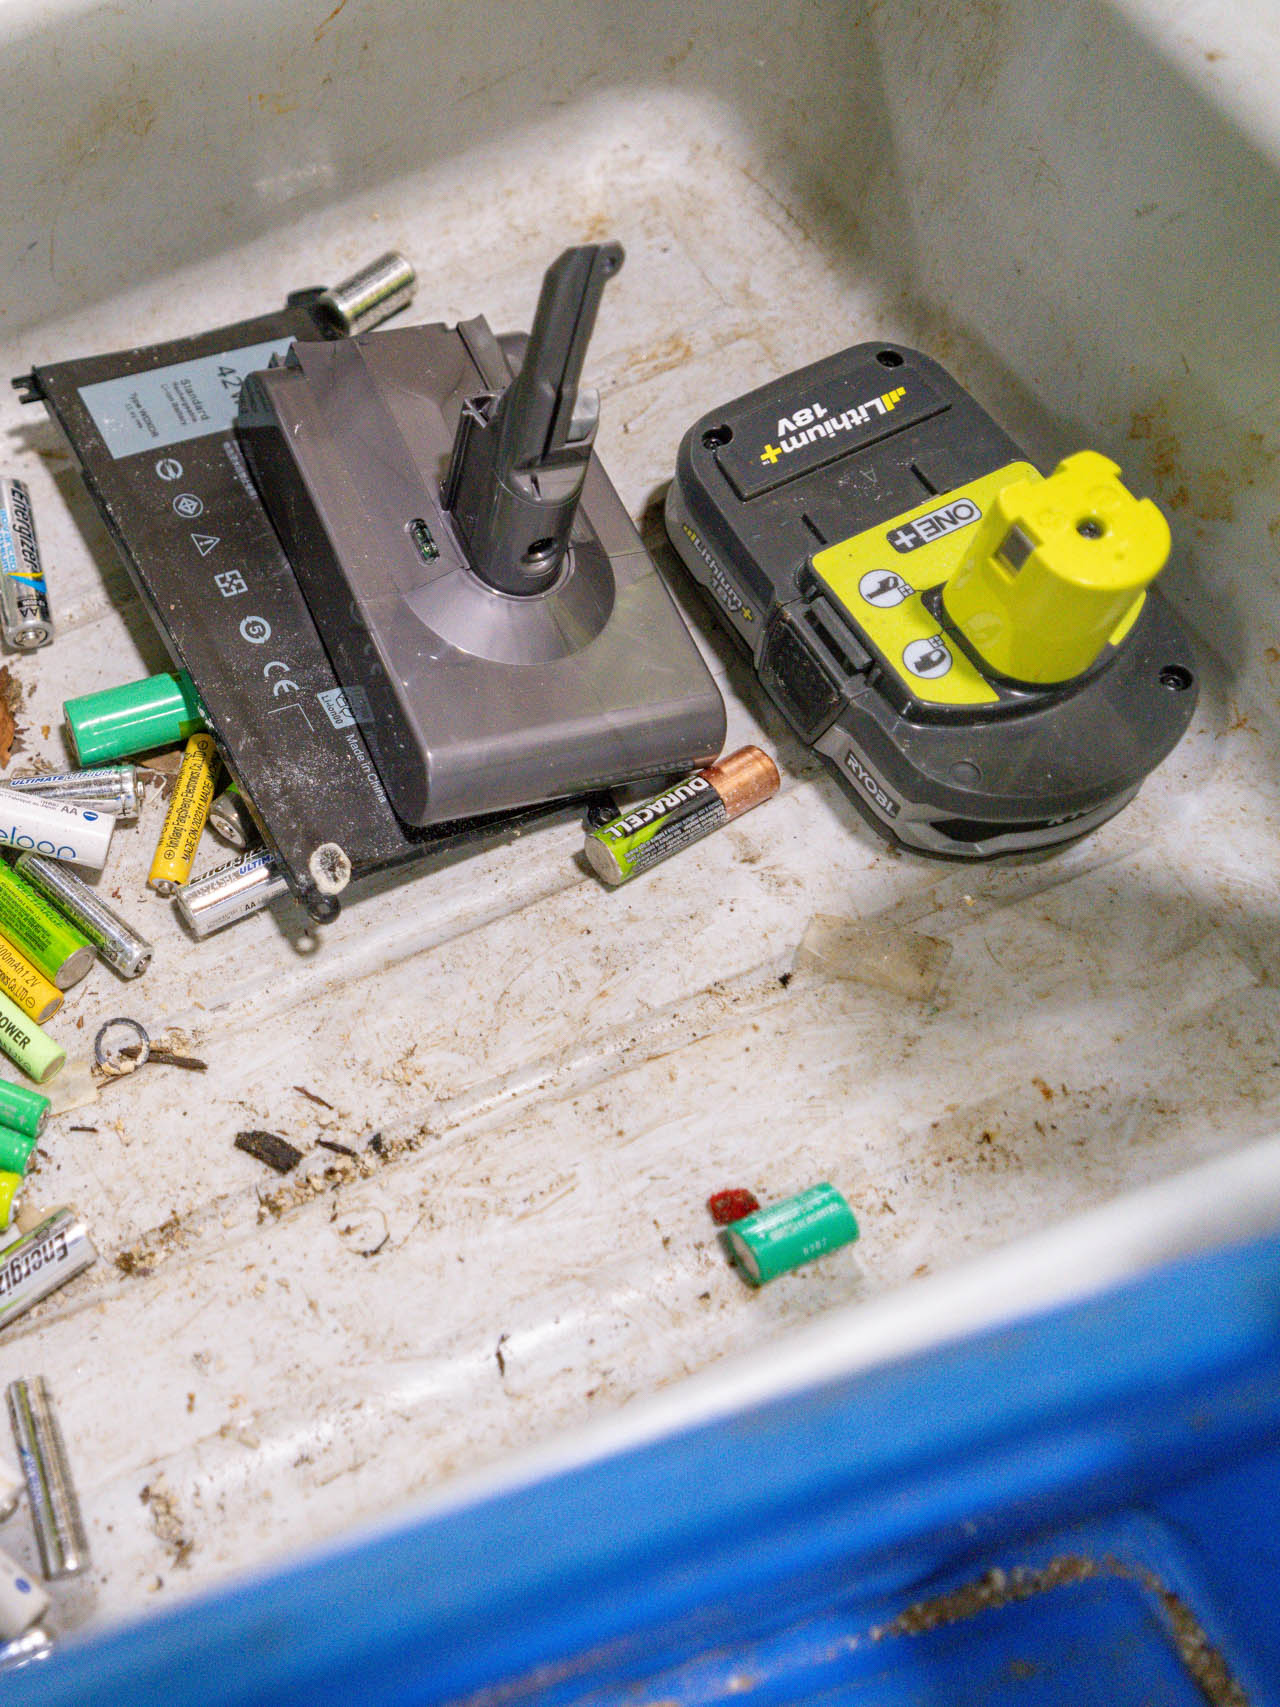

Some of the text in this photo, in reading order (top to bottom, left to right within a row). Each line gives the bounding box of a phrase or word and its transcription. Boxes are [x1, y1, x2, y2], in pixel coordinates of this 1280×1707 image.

[776, 402, 828, 437] 18V
[10, 488, 37, 572] Energizer
[345, 732, 389, 804] Made in China
[10, 773, 64, 787] ULTIMATE
[840, 753, 899, 812] RYOBI
[199, 781, 214, 803] MADE
[60, 804, 78, 815] AA
[602, 776, 709, 838] DURACELL
[187, 827, 199, 840] ON
[181, 840, 195, 861] MADE
[244, 901, 256, 910] AA
